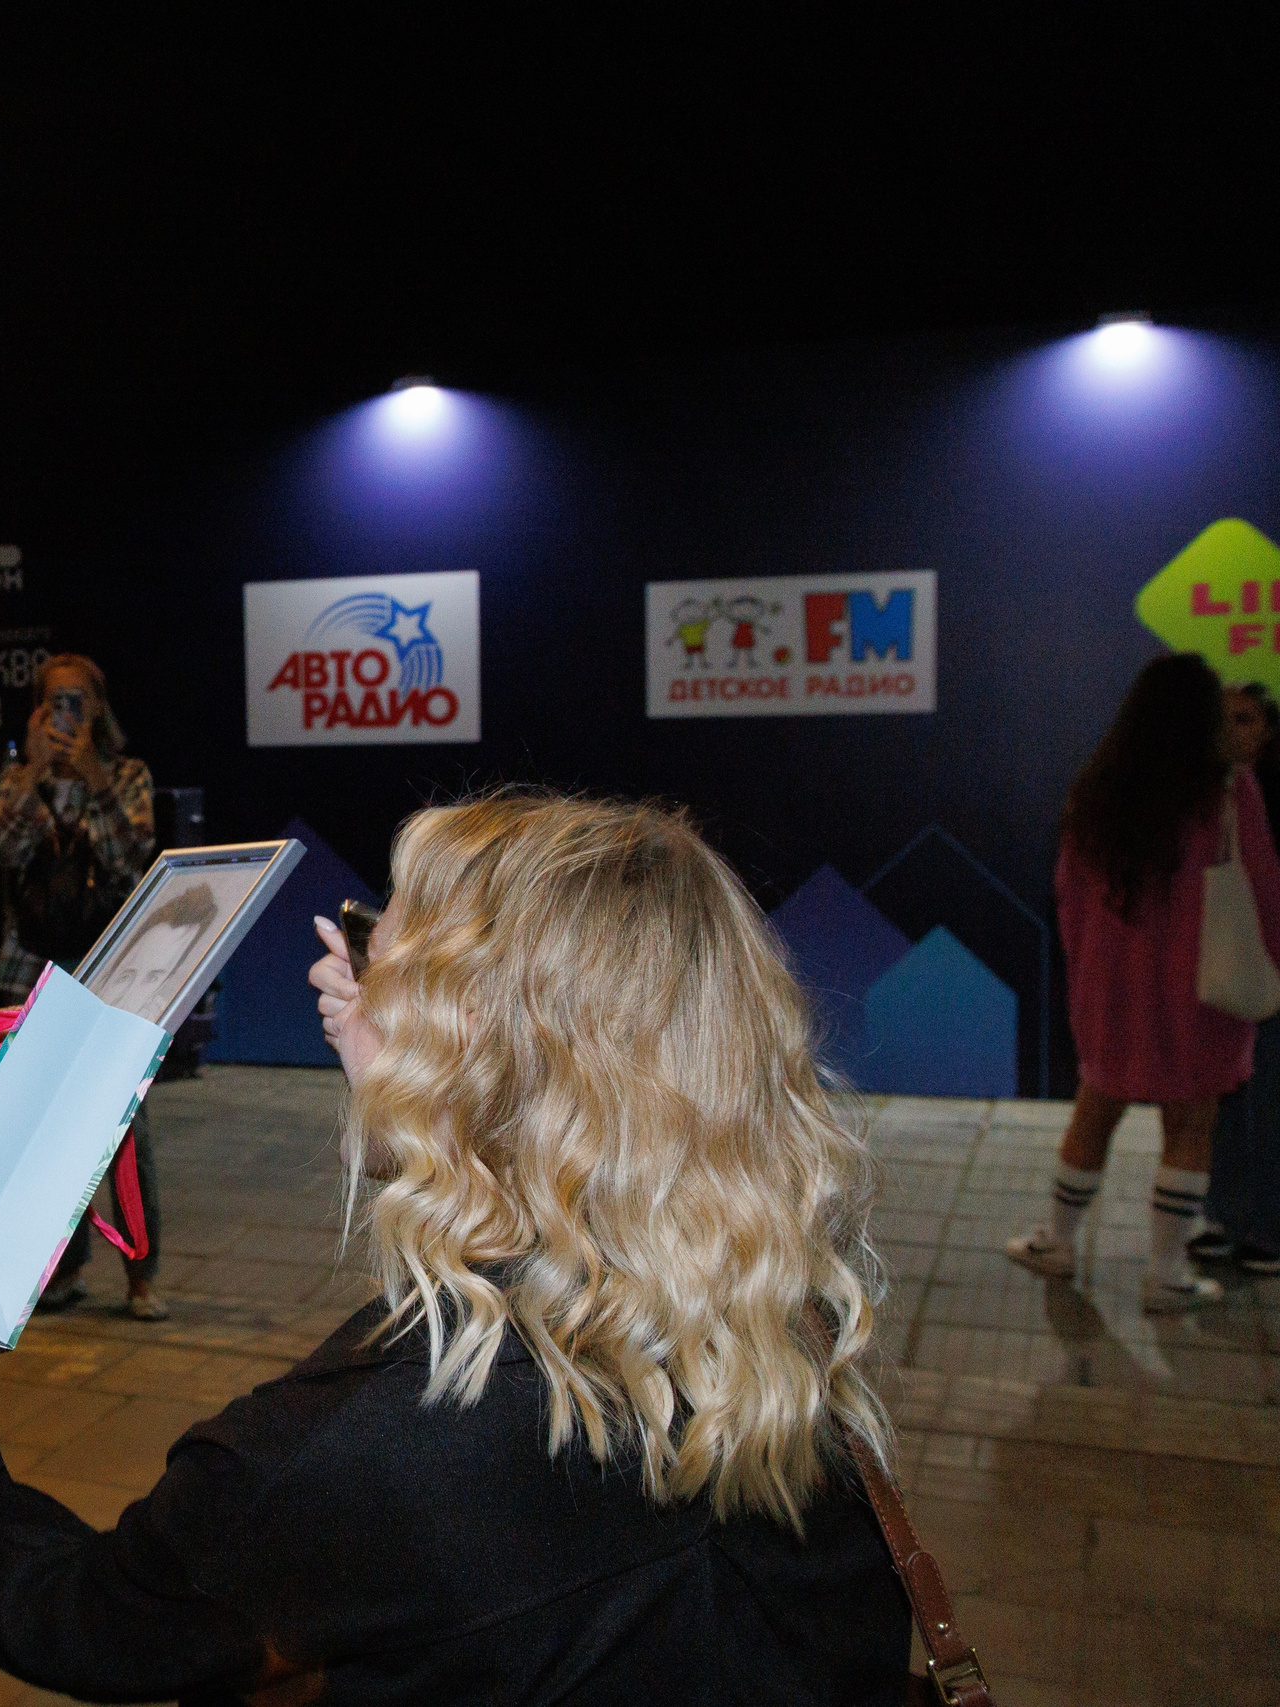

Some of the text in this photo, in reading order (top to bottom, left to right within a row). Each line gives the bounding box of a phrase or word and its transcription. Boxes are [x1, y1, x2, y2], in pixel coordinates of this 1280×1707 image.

[1193, 580, 1280, 616] LI
[1230, 623, 1280, 655] F
[268, 649, 390, 690] АВТО
[669, 673, 916, 701] ДЕТСКОЕ РАДИО
[303, 687, 458, 729] РАДИО
